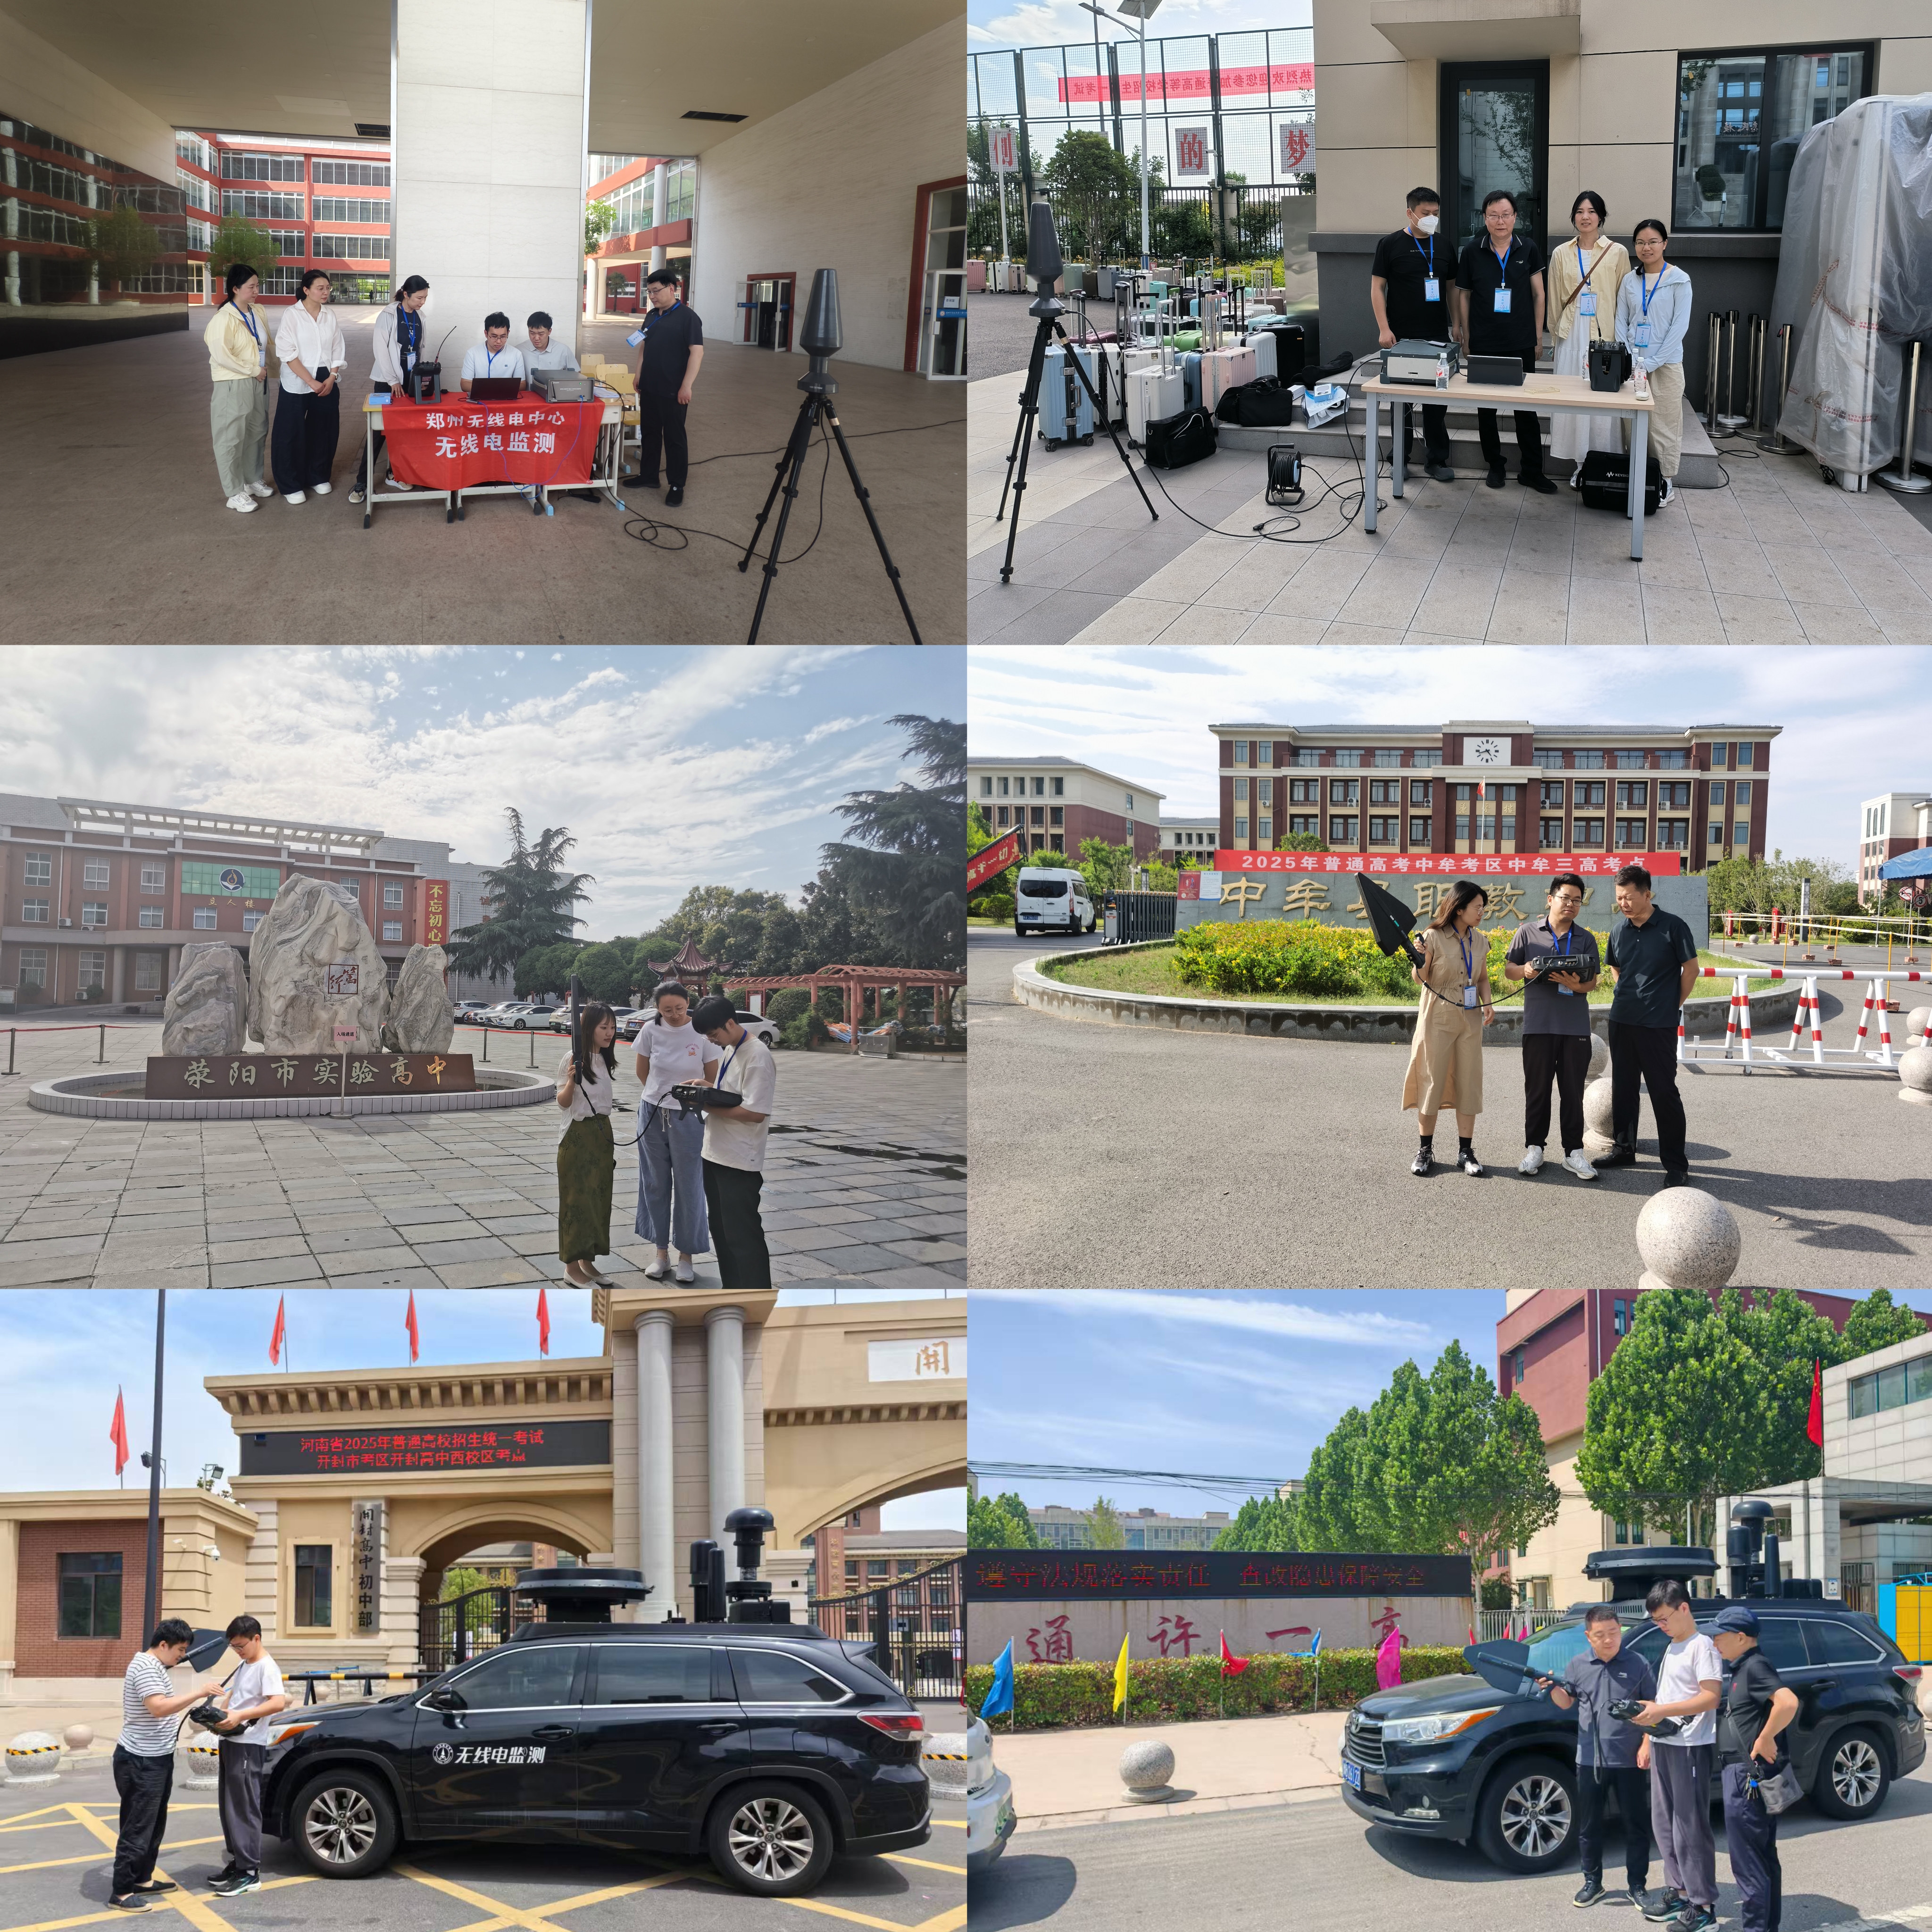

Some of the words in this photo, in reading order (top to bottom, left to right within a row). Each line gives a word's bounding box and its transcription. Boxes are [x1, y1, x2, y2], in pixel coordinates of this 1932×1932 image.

[1180, 133, 1203, 170] 的
[1286, 130, 1310, 168] 梦
[426, 411, 565, 430] 郑州无线电中心
[435, 432, 555, 458] 无线电监测
[1241, 855, 1645, 873] 2025年普通高考中牟考区中牟三高考点
[208, 897, 255, 908] 立人楼
[1918, 897, 1923, 905] 5
[428, 885, 443, 947] 不忘初心
[184, 1055, 447, 1089] 荥阳市实验高中
[300, 1429, 544, 1453] 河南省2025年普通高校招生统一考试
[317, 1449, 526, 1470] 开封市考区开封高中西校区考点
[455, 1746, 546, 1764] 无线电监测
